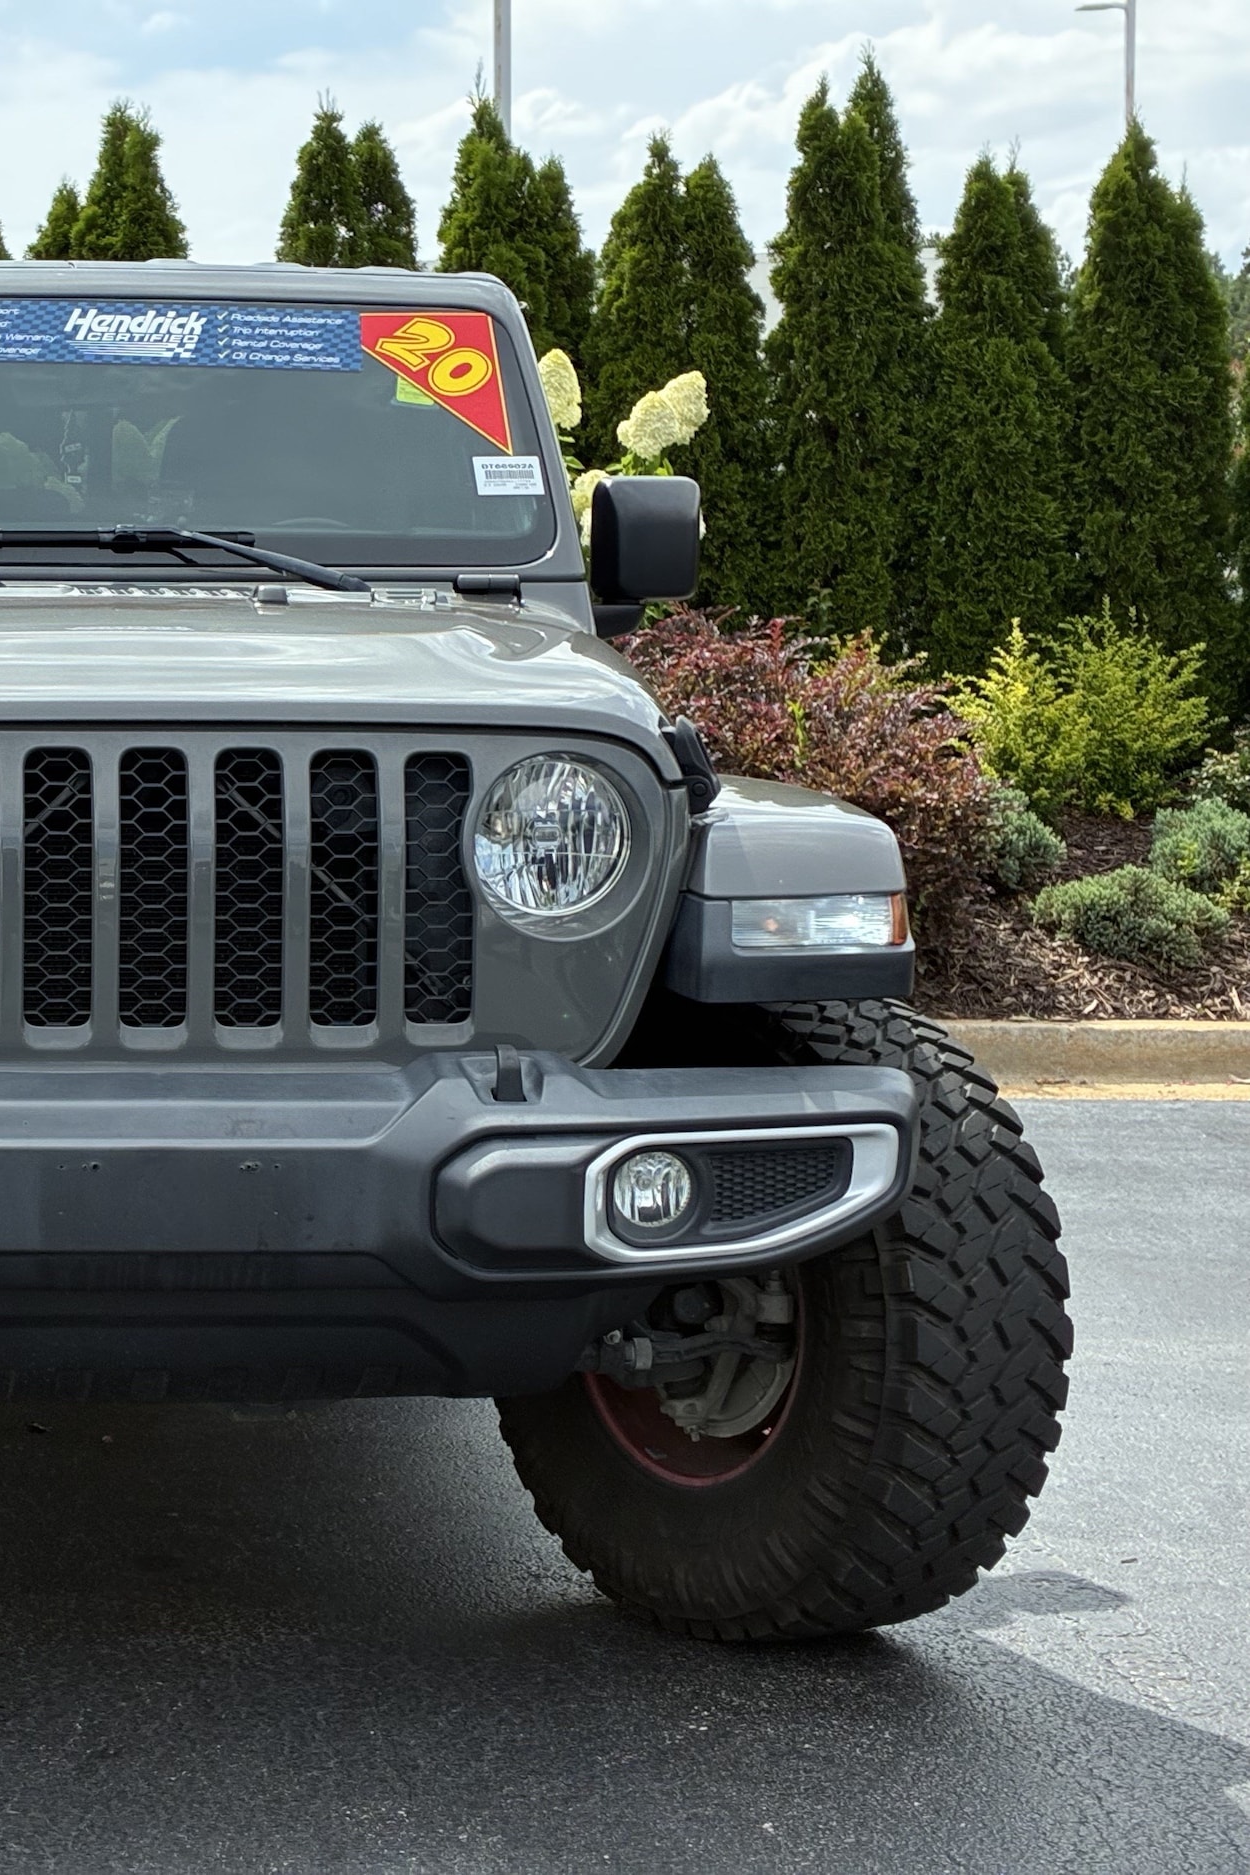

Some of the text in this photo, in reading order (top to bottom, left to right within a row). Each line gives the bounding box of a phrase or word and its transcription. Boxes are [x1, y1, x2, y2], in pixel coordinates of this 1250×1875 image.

[230, 313, 279, 322] Roadside
[63, 308, 207, 340] Hendrick
[232, 326, 251, 335] Trip
[86, 332, 199, 344] CERTIFIED
[231, 338, 268, 348] Rental
[250, 353, 291, 362] Change
[375, 317, 493, 397] 20
